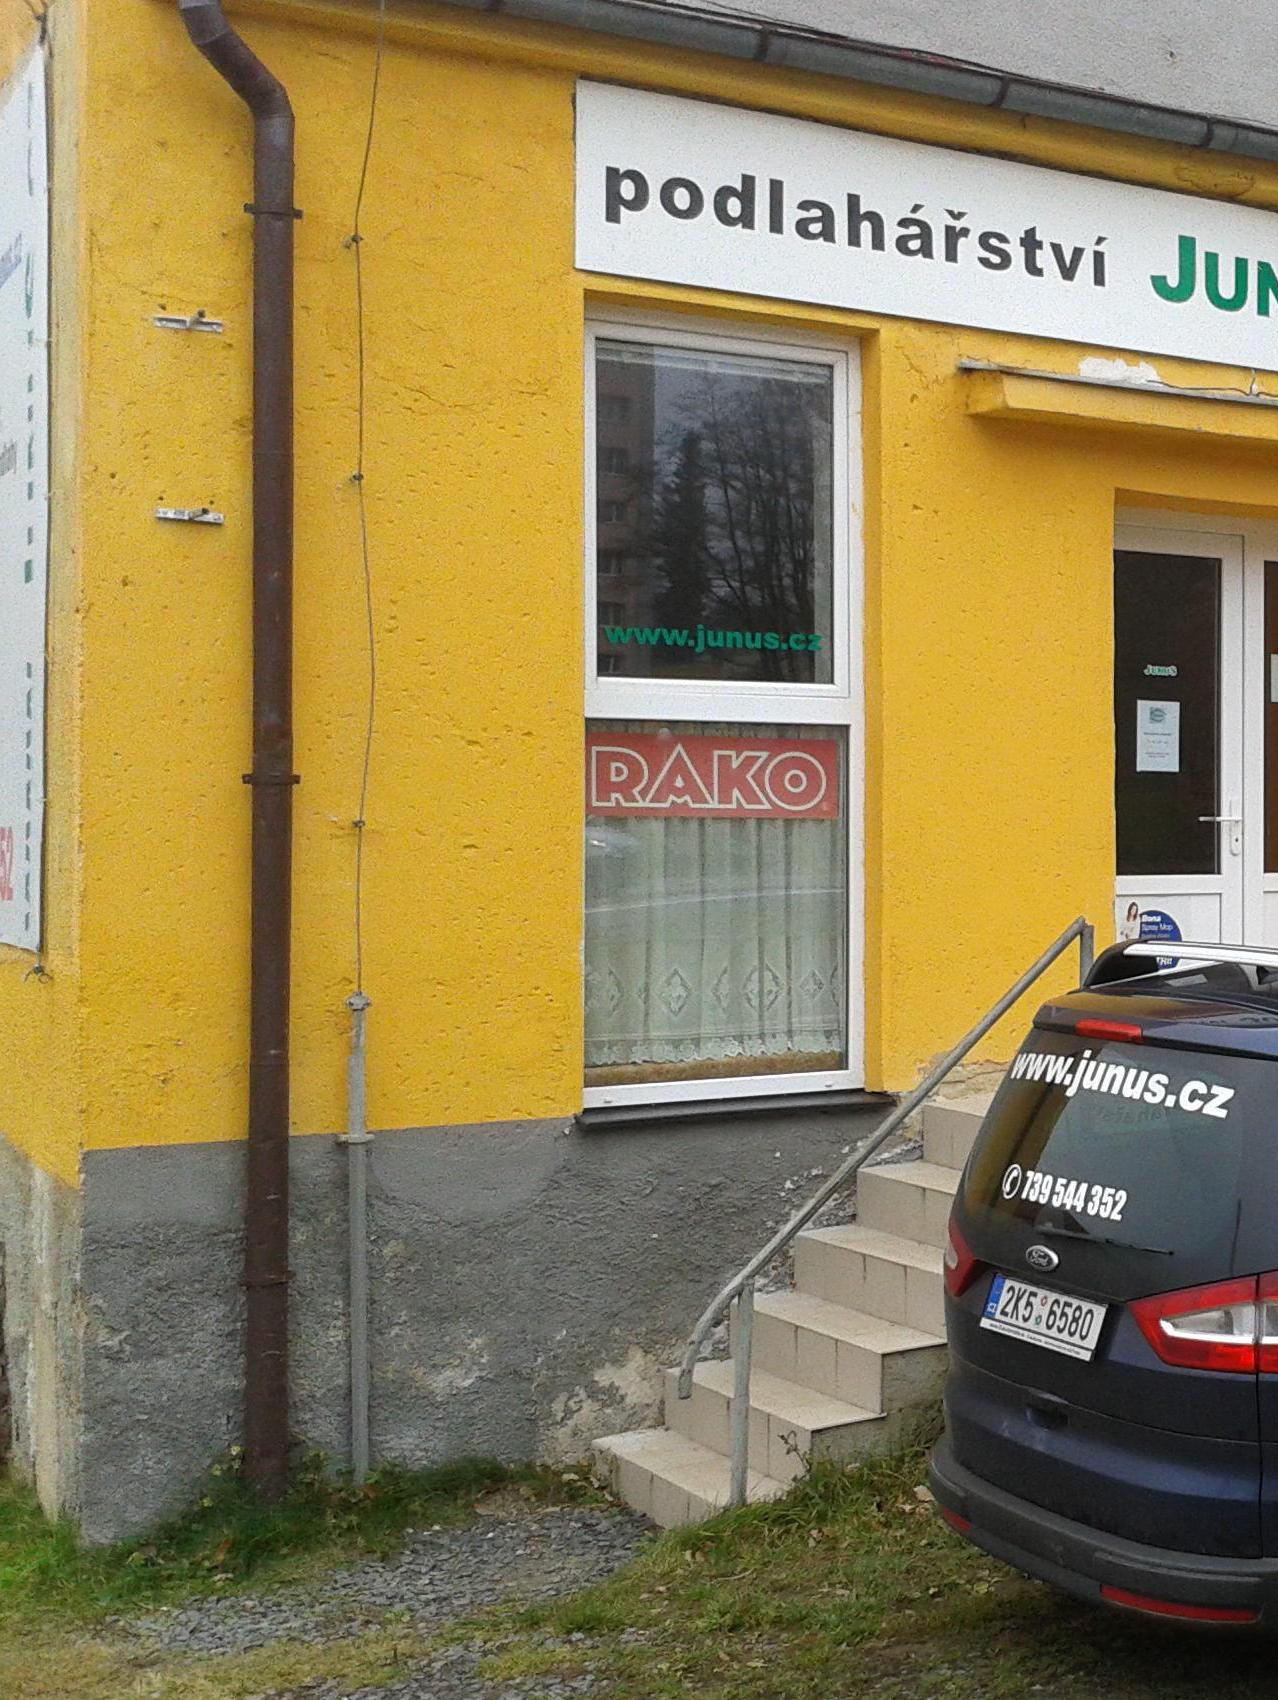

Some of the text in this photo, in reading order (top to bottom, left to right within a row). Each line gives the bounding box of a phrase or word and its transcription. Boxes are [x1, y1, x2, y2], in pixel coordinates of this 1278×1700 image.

[604, 166, 1108, 288] podlahářství
[605, 624, 823, 653] www.junus.cz
[591, 743, 827, 811] RAKO
[1009, 1050, 1235, 1119] www.junus.cz
[999, 1285, 1039, 1324] 2K5
[1045, 1298, 1095, 1341] 6580
